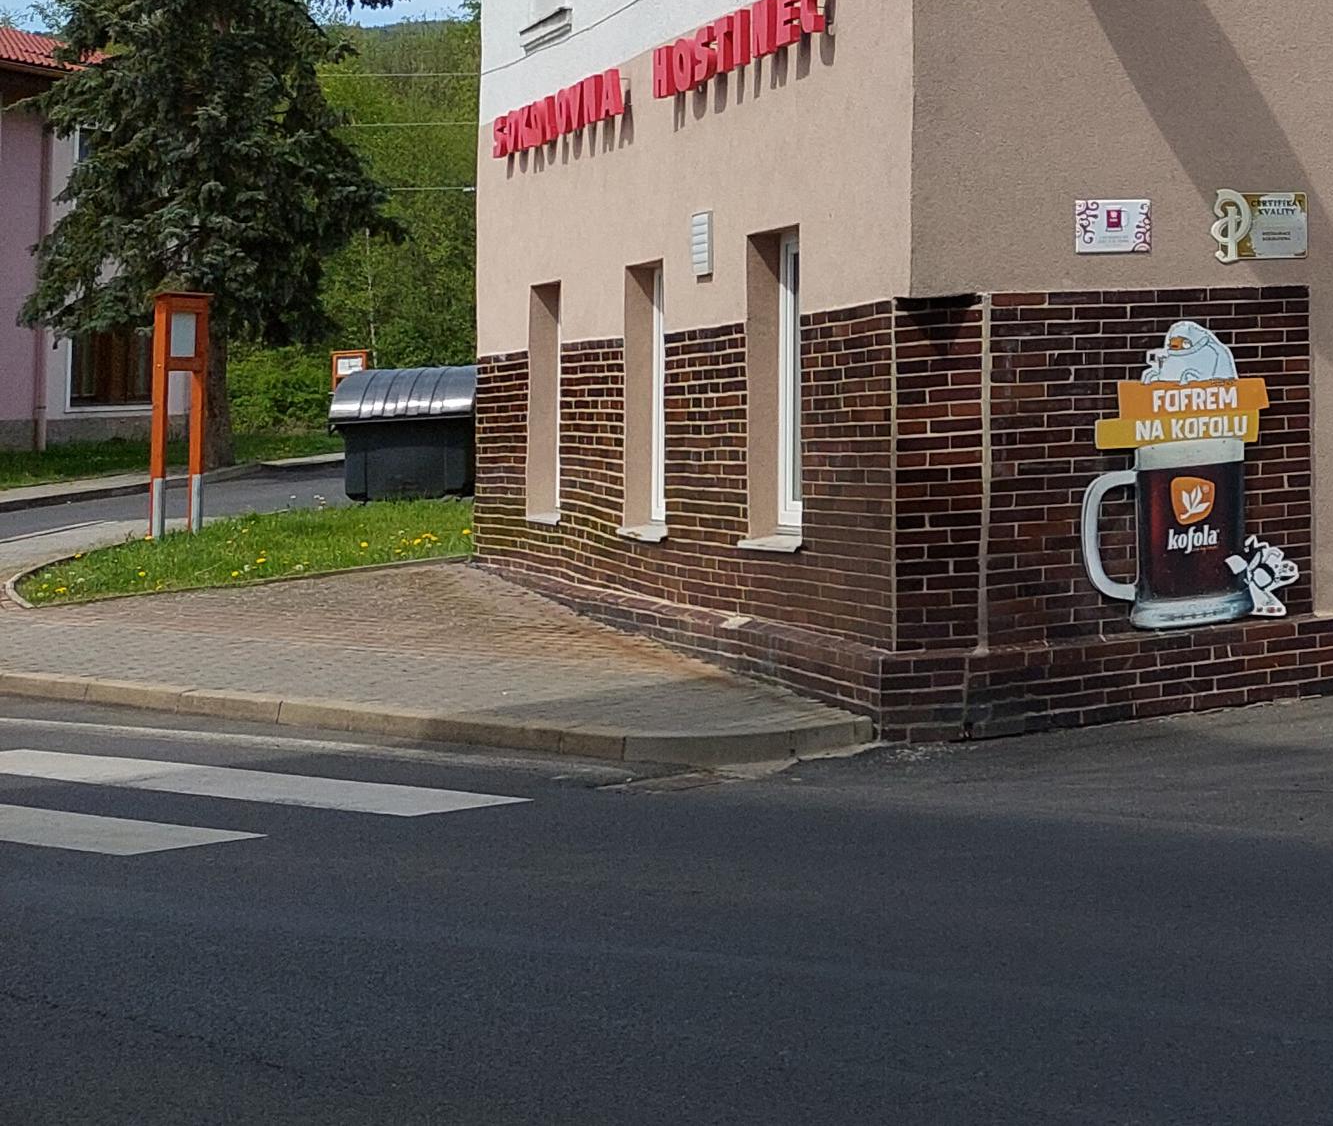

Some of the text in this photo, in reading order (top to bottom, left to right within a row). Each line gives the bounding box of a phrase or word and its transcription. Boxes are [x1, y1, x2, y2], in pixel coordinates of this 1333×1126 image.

[1151, 385, 1238, 413] FOFREM
[1135, 415, 1248, 441] NA KOFOLU
[1167, 523, 1218, 555] kofola
